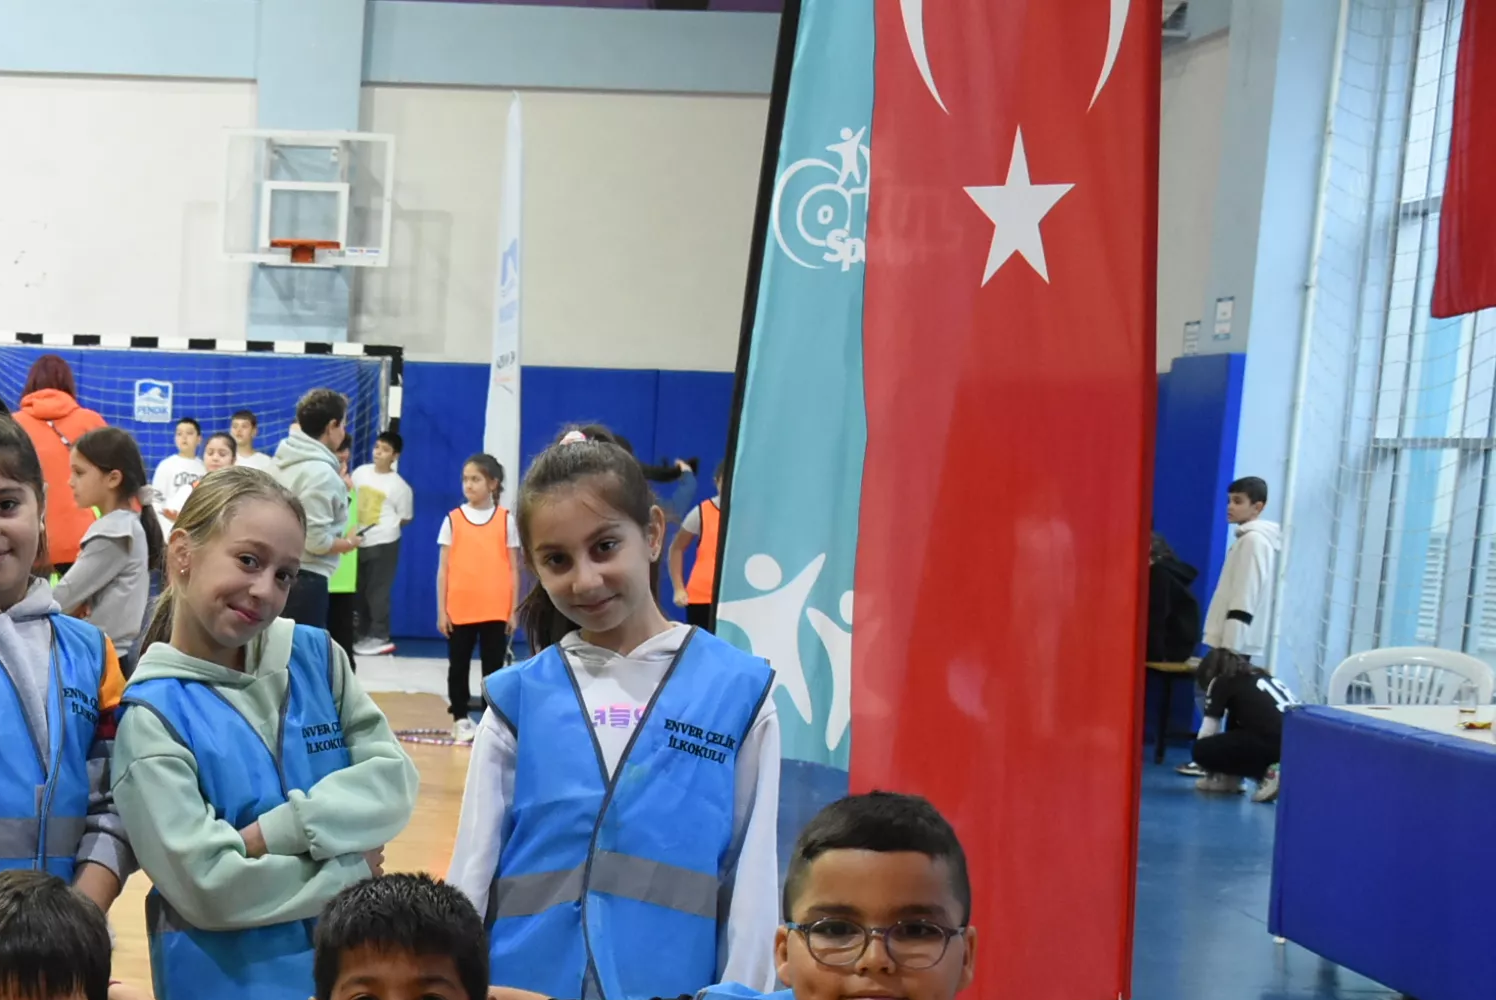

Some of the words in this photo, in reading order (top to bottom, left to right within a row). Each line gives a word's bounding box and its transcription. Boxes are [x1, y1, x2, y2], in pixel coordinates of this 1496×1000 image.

[664, 718, 703, 740] ENVER
[705, 730, 736, 751] ÇELİK
[668, 735, 727, 764] İLKOKULU
